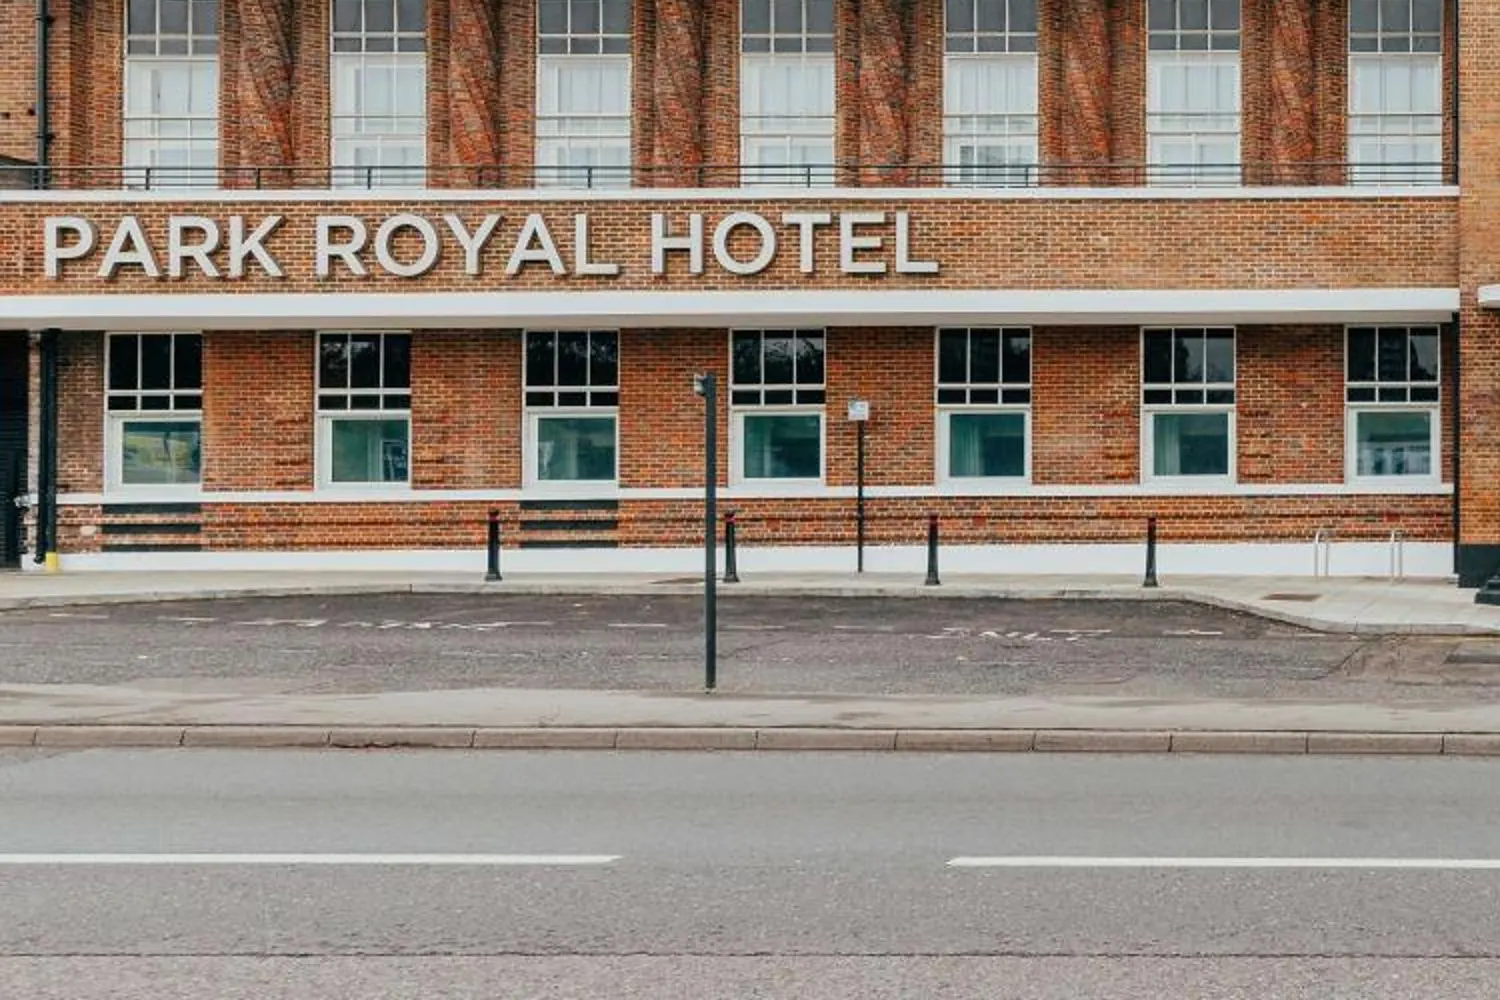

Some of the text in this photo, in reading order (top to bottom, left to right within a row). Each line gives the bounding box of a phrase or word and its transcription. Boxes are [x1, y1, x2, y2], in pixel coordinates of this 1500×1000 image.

[43, 210, 941, 279] PARK ROYAL HOTEL
